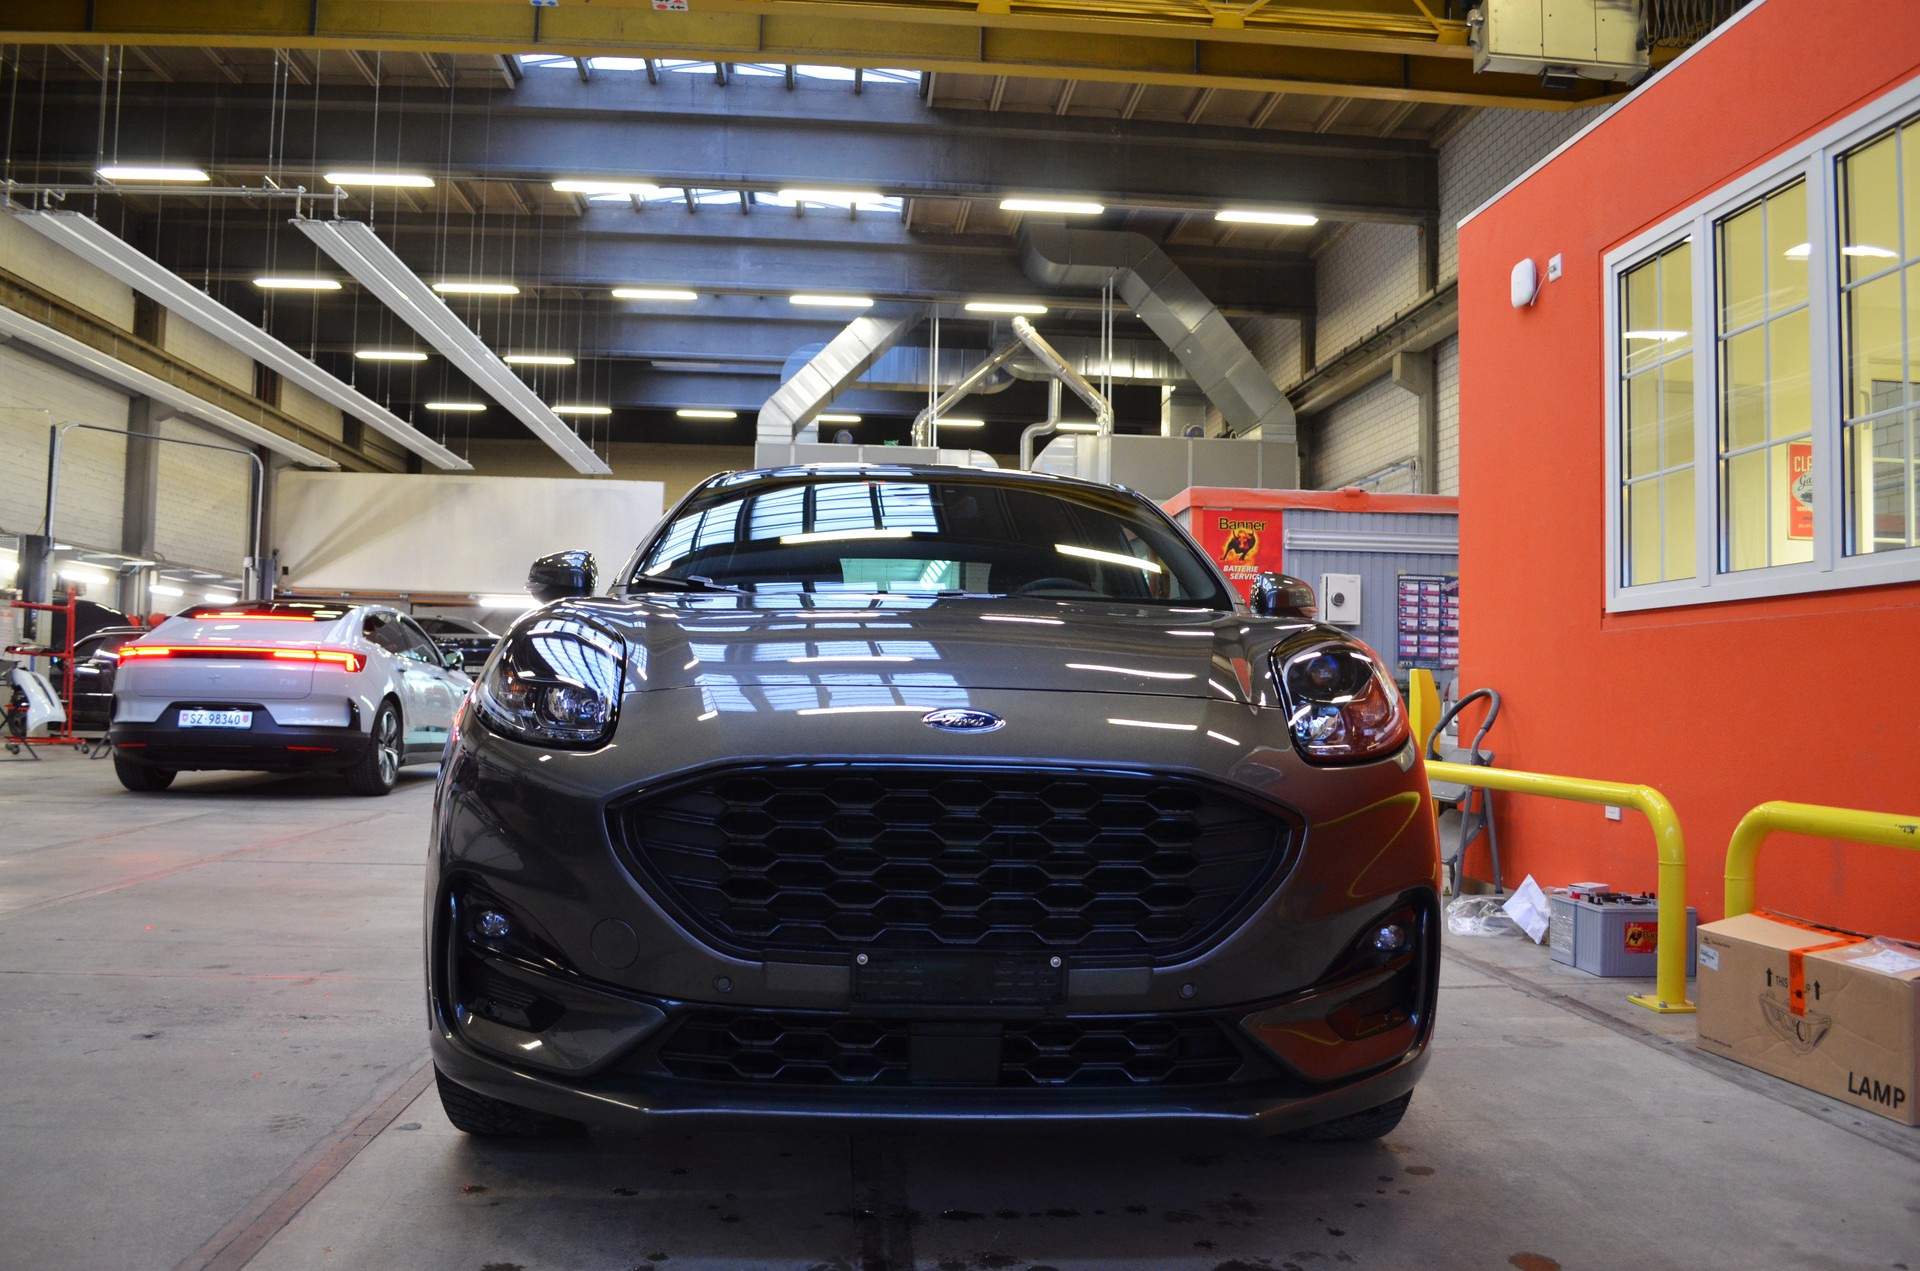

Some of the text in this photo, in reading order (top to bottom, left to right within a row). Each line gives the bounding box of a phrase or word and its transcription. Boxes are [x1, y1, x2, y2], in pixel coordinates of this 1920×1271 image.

[1219, 517, 1267, 531] Banner
[1223, 565, 1259, 573] BATTERIE
[1775, 975, 1788, 989] THIS
[1848, 1070, 1906, 1109] LAMP
